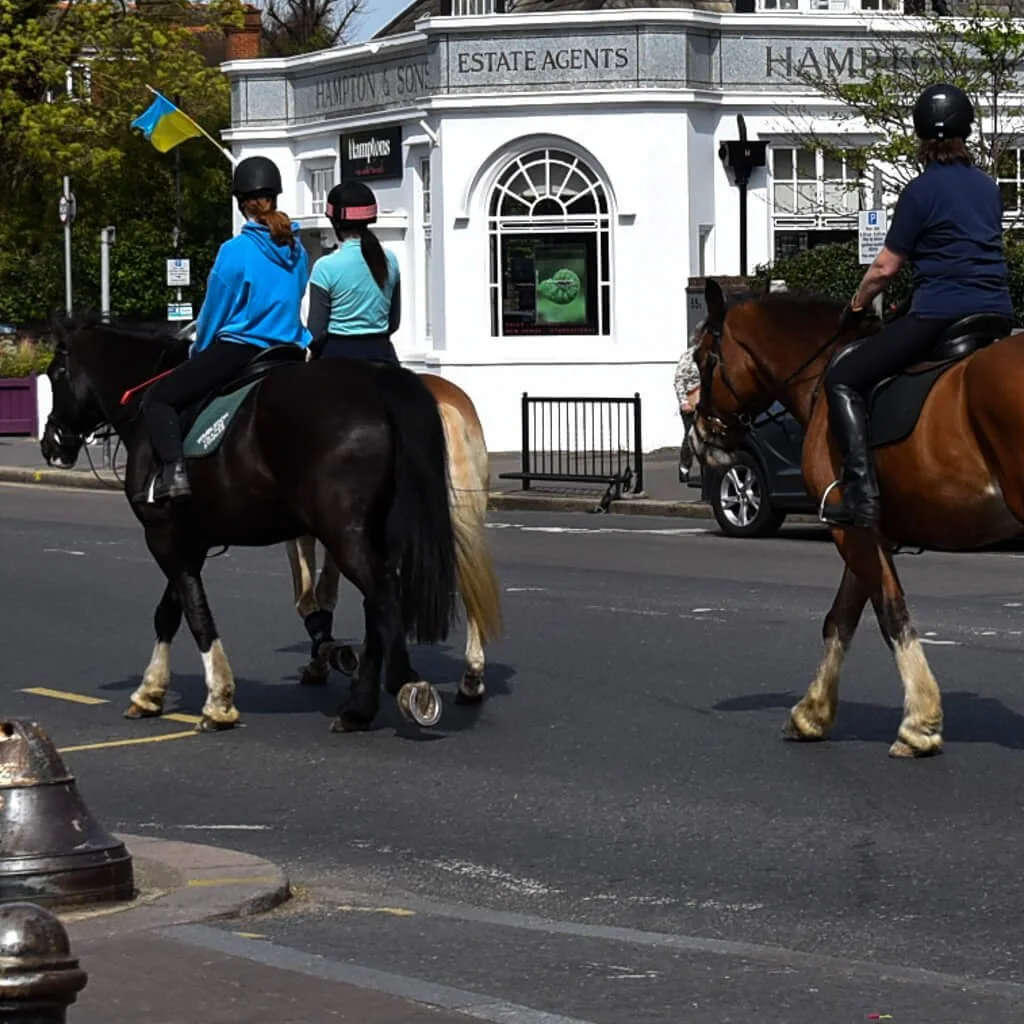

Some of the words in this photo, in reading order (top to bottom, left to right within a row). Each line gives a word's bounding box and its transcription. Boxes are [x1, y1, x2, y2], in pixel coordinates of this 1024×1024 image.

[458, 50, 538, 73] ESTATE
[541, 47, 629, 70] AGENTS
[315, 71, 376, 109] HAMPTON
[348, 136, 391, 165] Hamptons
